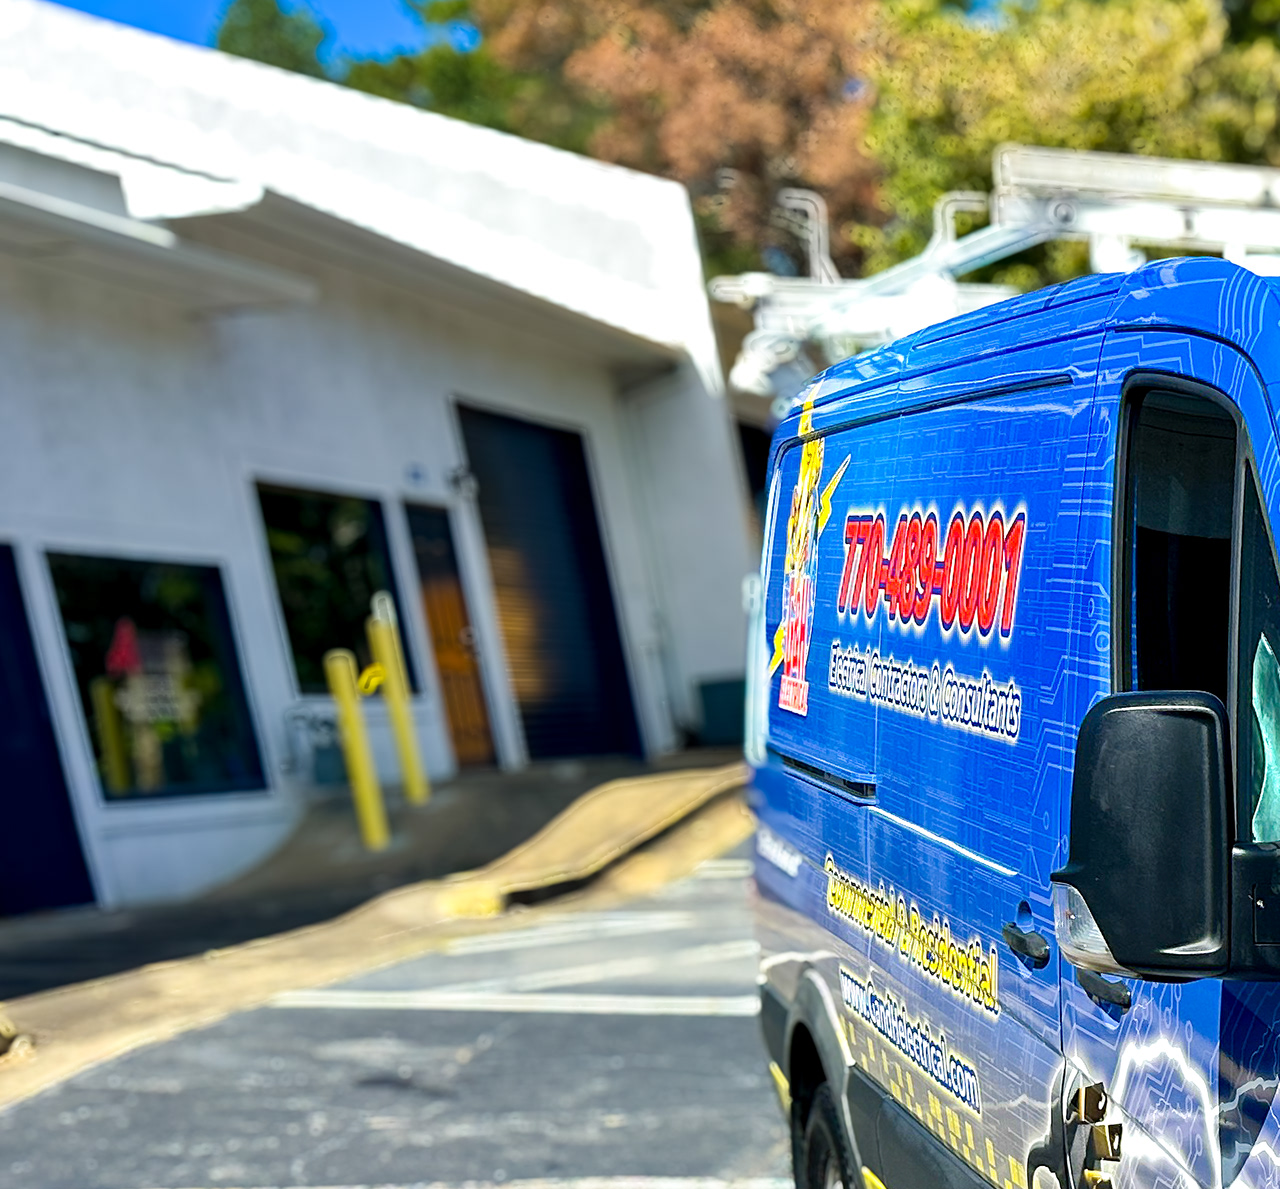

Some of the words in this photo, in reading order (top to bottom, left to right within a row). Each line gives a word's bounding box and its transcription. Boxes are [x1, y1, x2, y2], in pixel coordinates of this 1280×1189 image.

[838, 510, 1026, 637] 770-489-0001
[829, 643, 869, 695] Electrical
[869, 652, 928, 712] Contractors
[929, 663, 940, 715] &
[941, 668, 1021, 738] Consultants
[824, 856, 896, 949] Commercial
[909, 905, 1001, 1015] Residential
